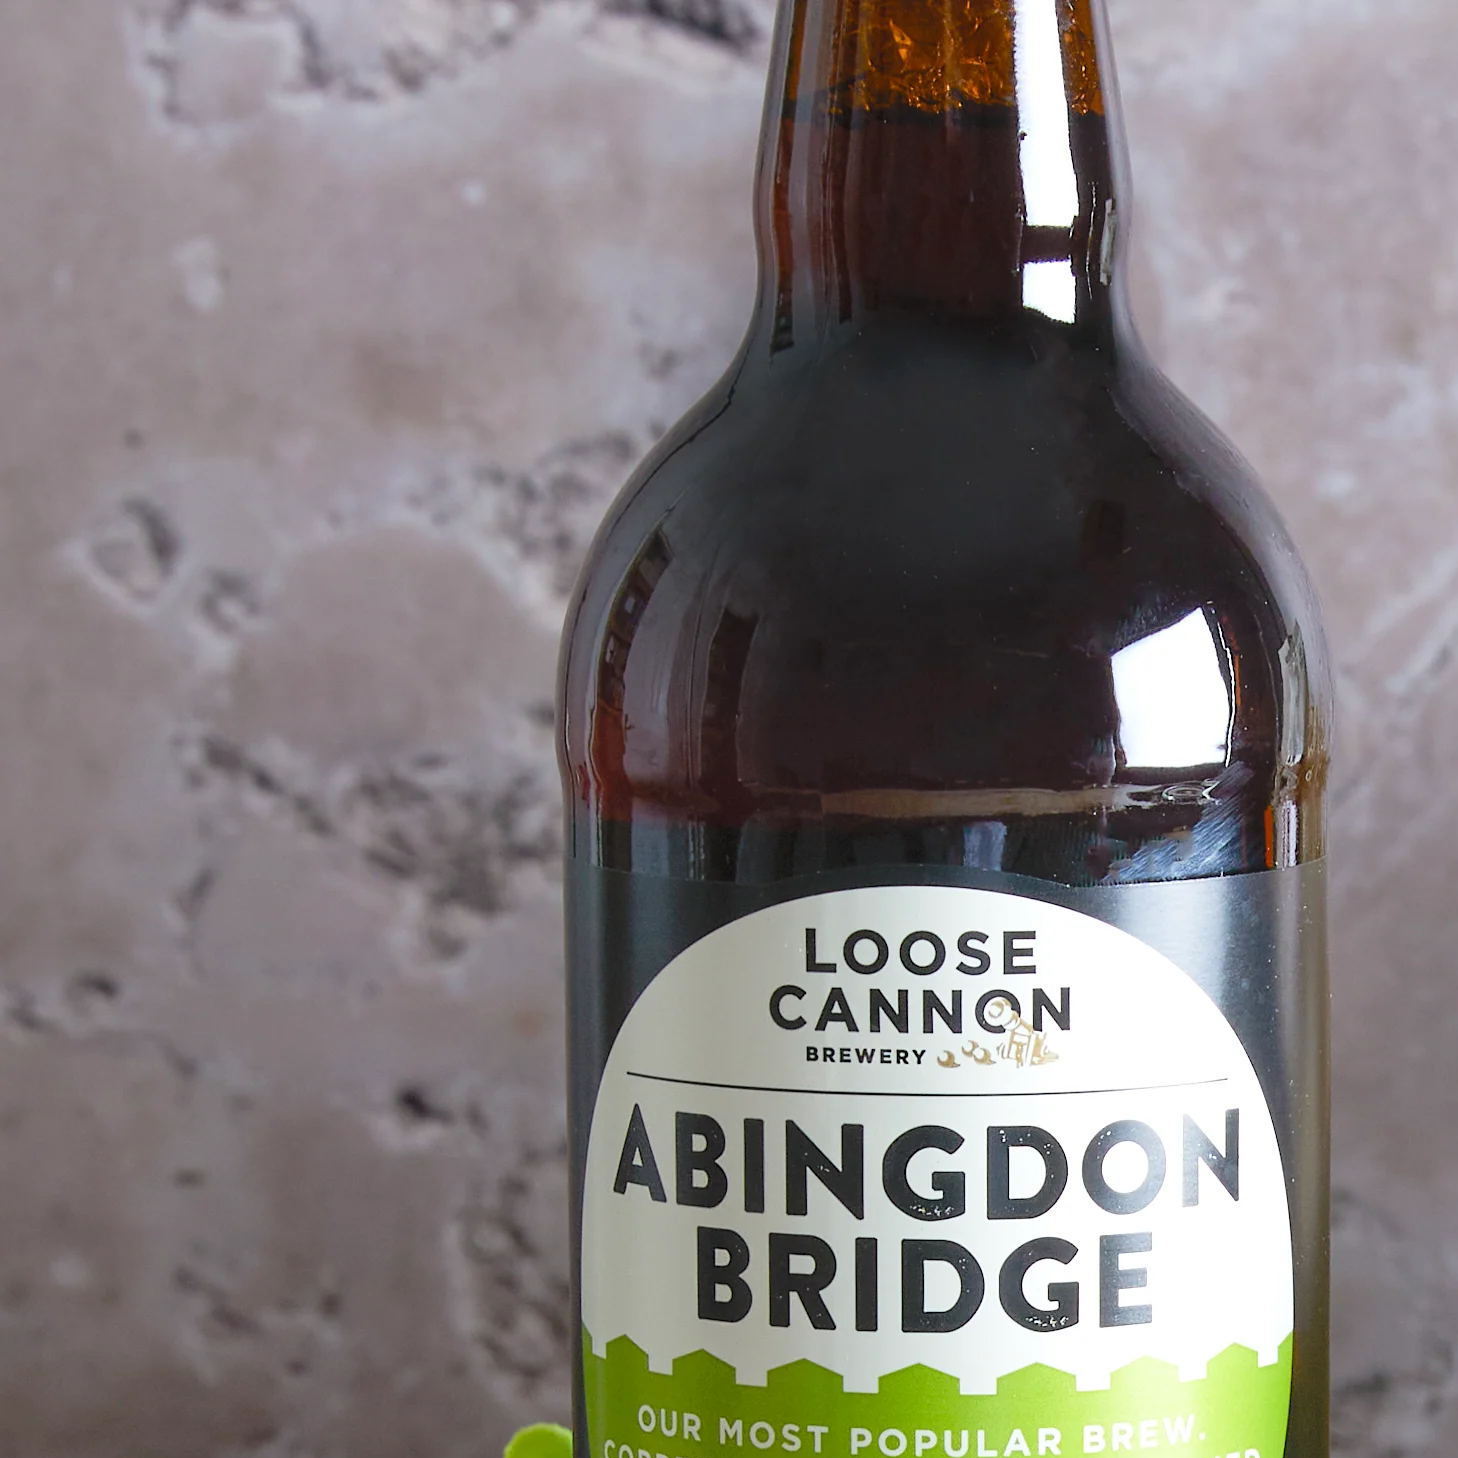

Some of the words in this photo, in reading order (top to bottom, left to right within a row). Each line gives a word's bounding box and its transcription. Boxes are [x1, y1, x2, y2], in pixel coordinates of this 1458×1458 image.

[805, 928, 1036, 976] LOOSE
[769, 984, 1070, 1033] CANNON
[806, 1046, 925, 1064] BREWERY
[613, 1103, 1239, 1221] ABINGDON
[696, 1225, 1153, 1333] BRIDGE
[638, 1405, 700, 1441] OUR
[720, 1418, 828, 1452] MOST
[851, 1427, 1062, 1458] POPULAR
[1084, 1414, 1205, 1452] BREW.
